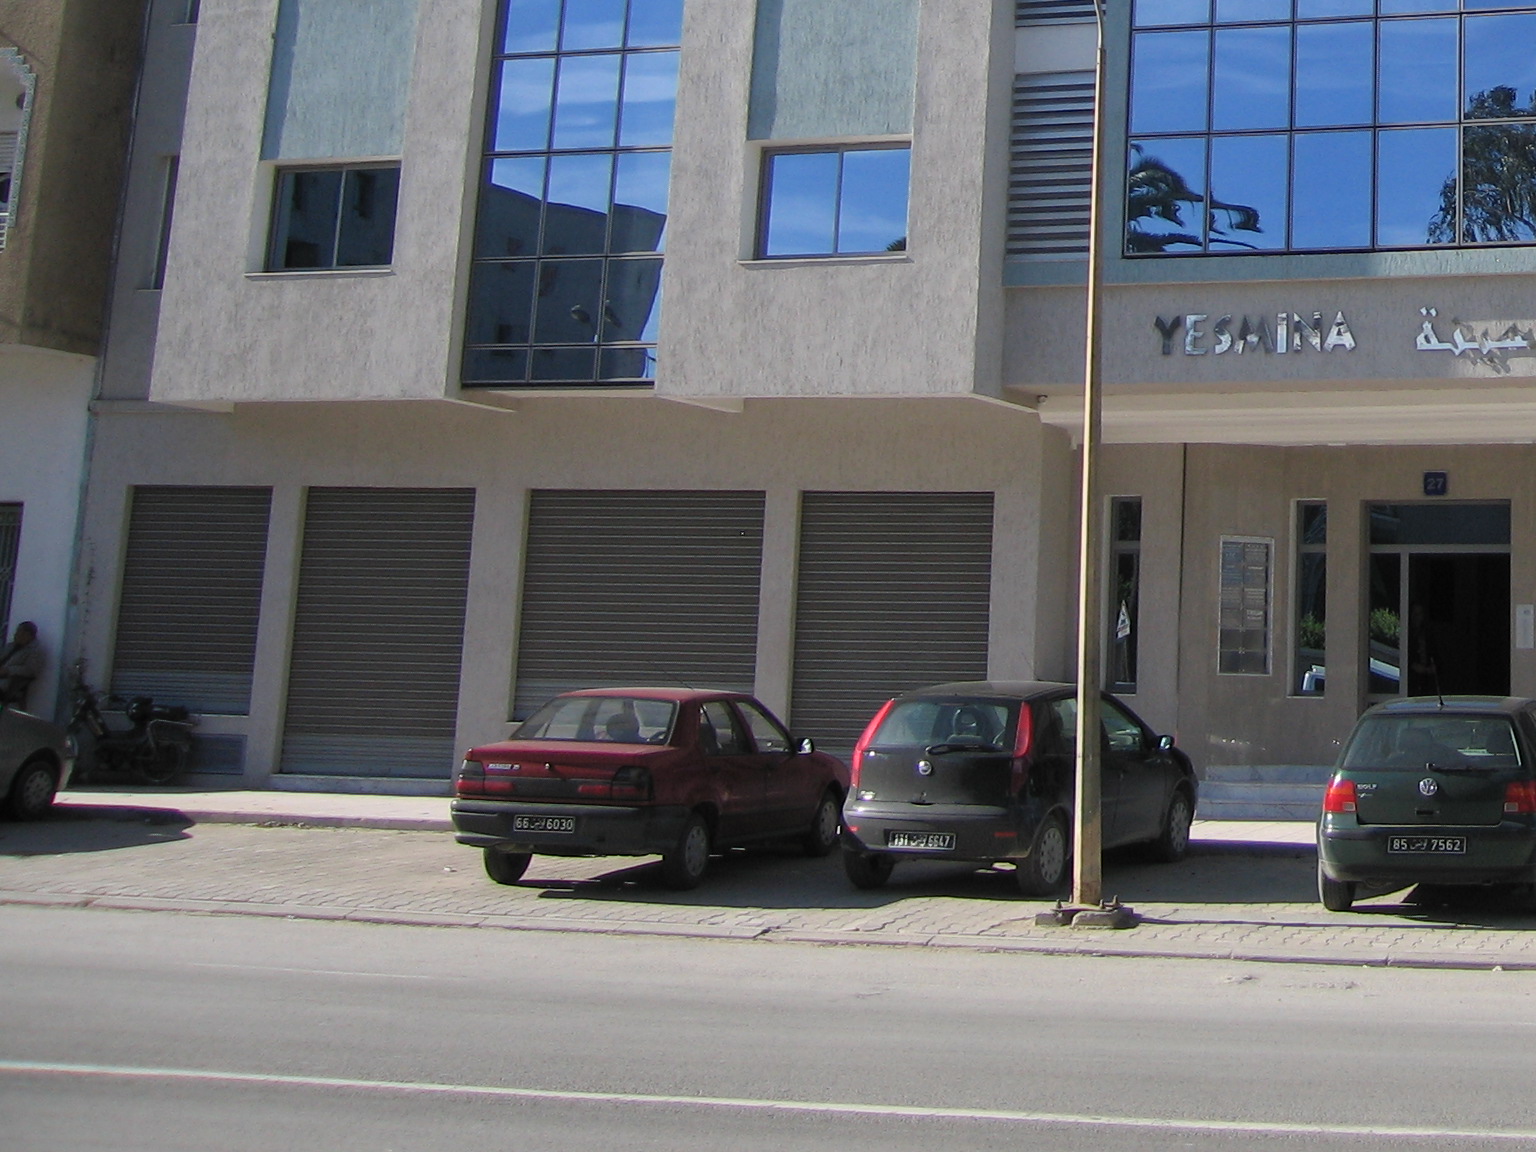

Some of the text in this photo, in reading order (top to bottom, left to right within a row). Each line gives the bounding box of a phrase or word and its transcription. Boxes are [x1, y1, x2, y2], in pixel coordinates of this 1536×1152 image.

[1153, 309, 1357, 357] YESMINA
[1426, 477, 1445, 490] 27
[516, 817, 530, 829] 66
[546, 818, 574, 830] 6030
[1393, 838, 1408, 850] 85
[1431, 839, 1461, 851] 7562
